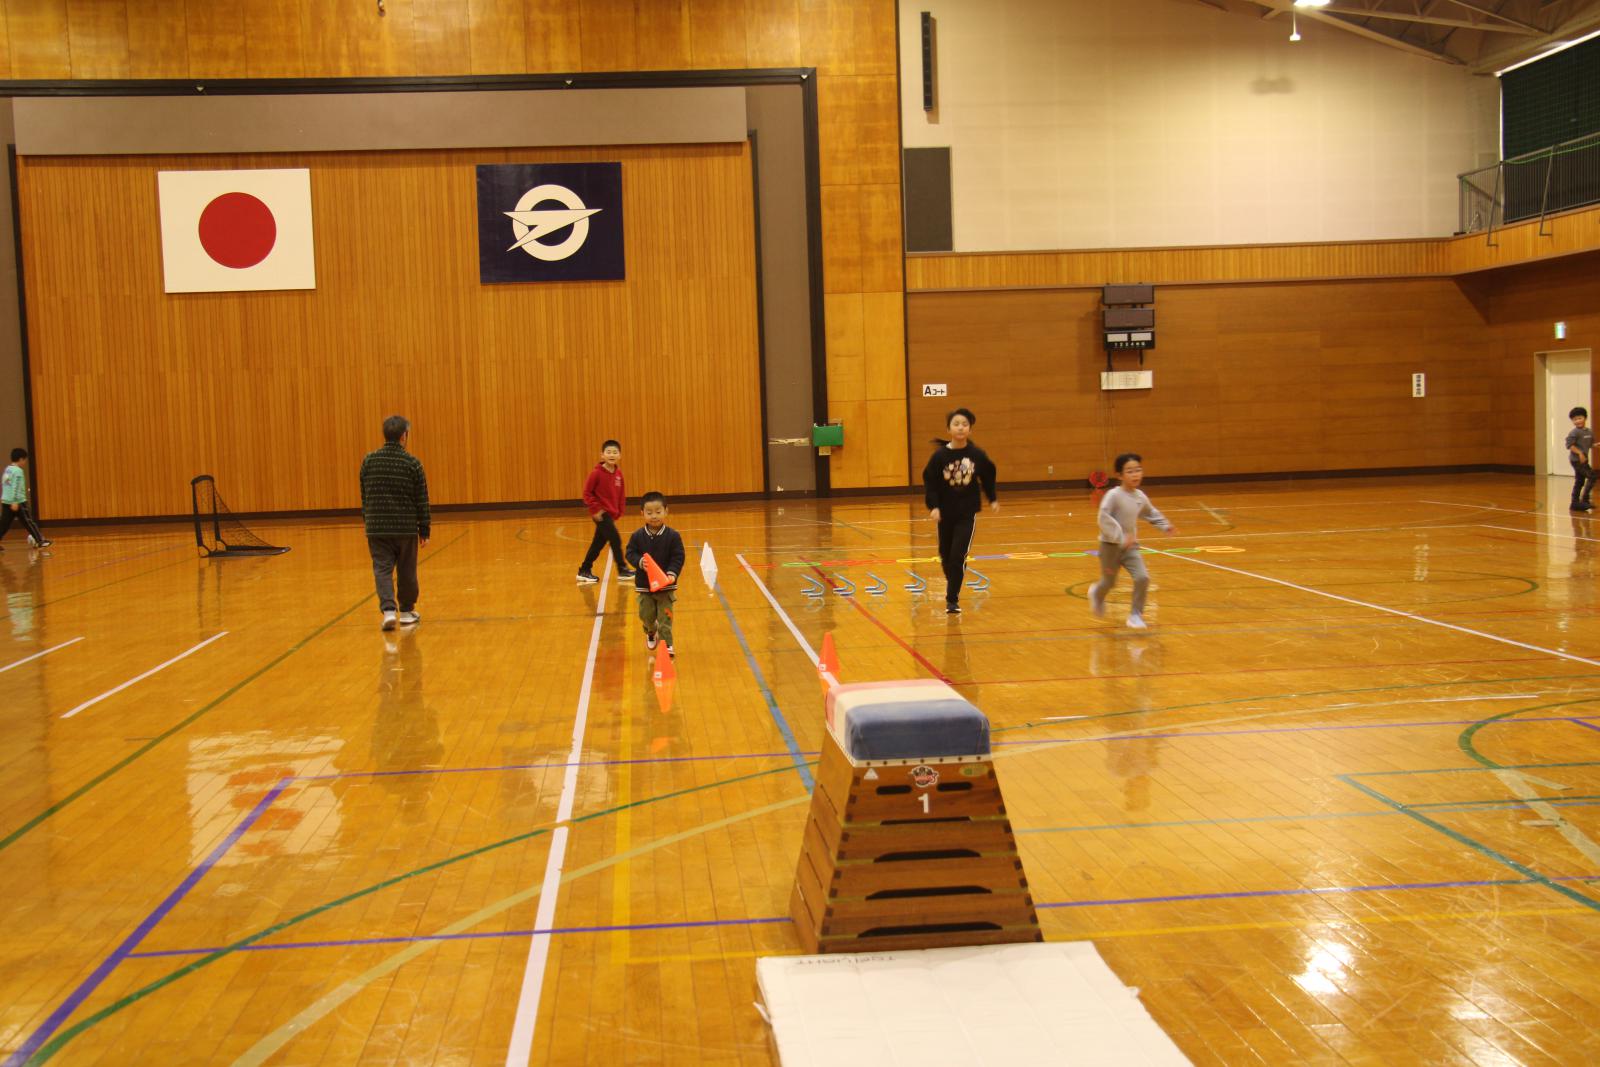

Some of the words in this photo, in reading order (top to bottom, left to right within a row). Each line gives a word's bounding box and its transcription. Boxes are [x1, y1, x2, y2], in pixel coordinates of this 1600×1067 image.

[925, 385, 945, 396] Aコート
[918, 793, 929, 814] 1
